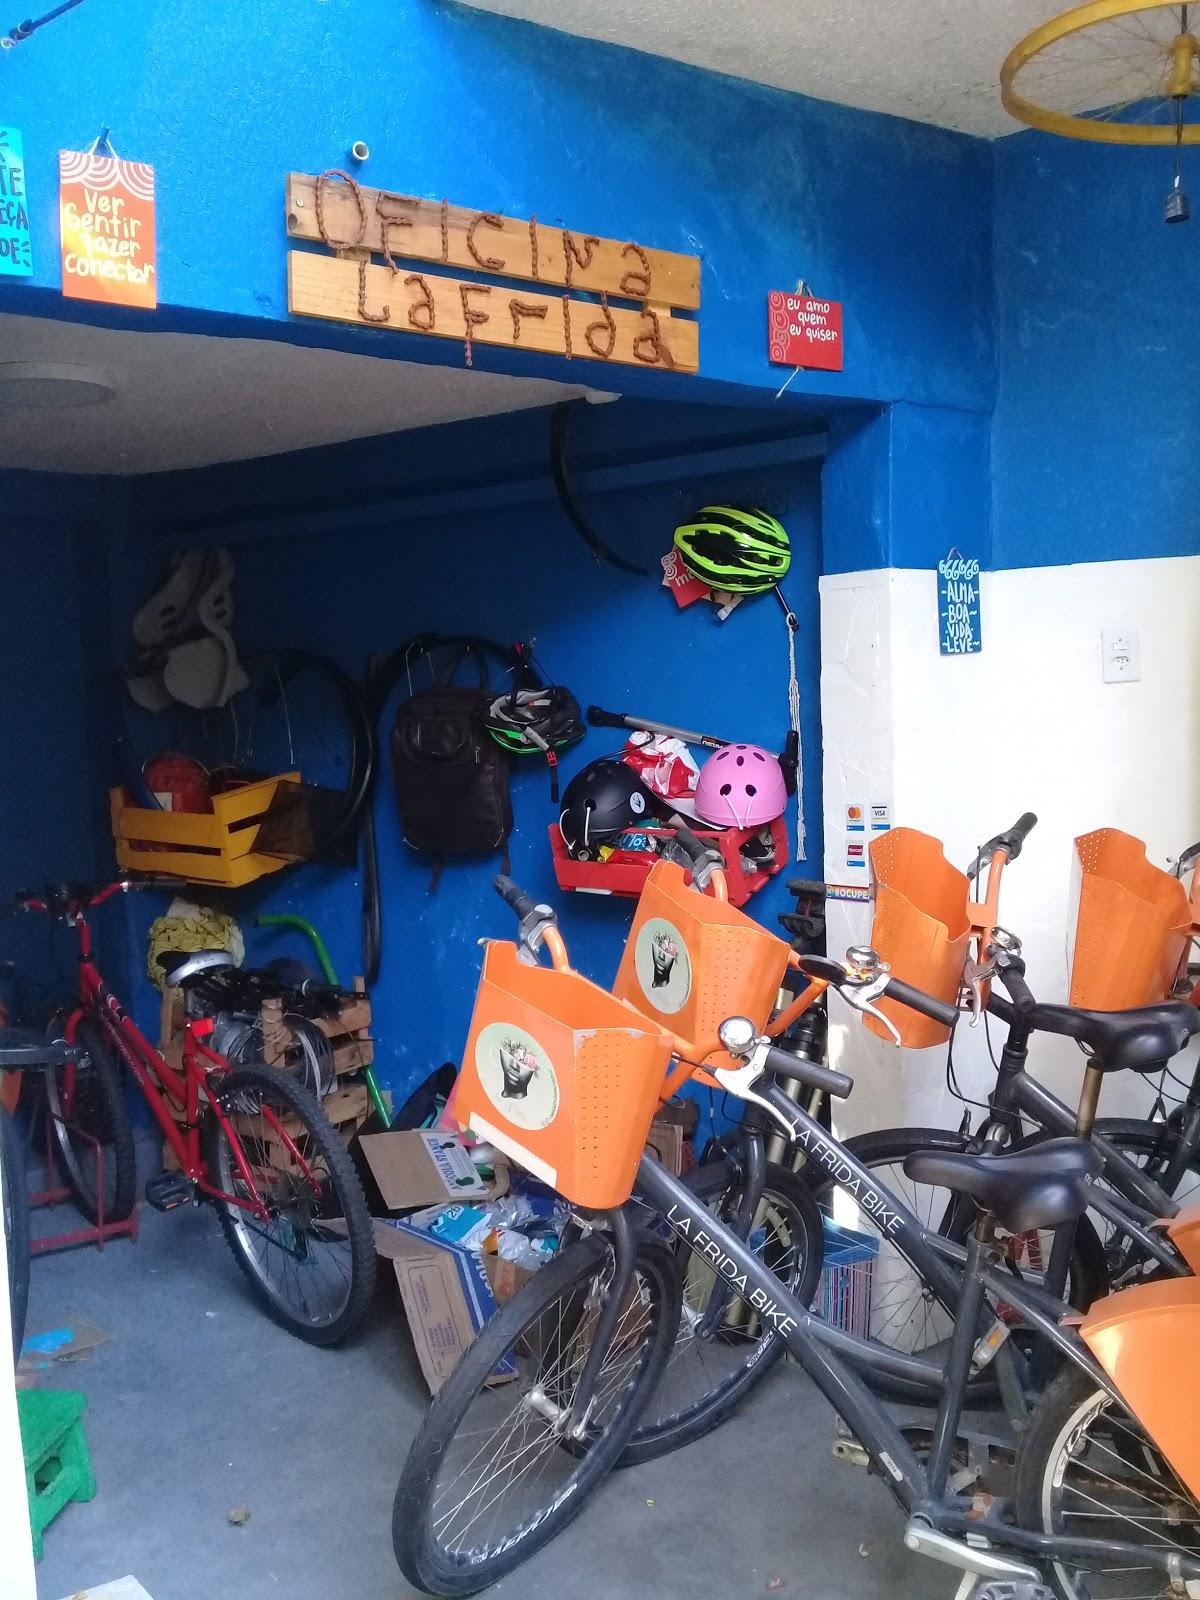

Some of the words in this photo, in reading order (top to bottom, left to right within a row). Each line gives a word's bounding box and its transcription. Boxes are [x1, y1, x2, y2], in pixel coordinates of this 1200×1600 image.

[83, 188, 125, 215] Ver
[64, 202, 142, 238] Sentir
[65, 253, 155, 284] Conector
[787, 297, 800, 310] eu
[806, 301, 829, 313] amo
[798, 311, 827, 326] quem
[789, 324, 801, 336] eu
[806, 327, 838, 343] quiser
[947, 580, 975, 604] ALMA
[948, 603, 970, 623] BOA
[947, 635, 974, 653] LEVE
[811, 1140, 861, 1195] FRIDA
[861, 1190, 905, 1234] BIKE
[667, 1204, 691, 1235] LA
[693, 1230, 748, 1292] FRIDA
[749, 1287, 798, 1338] BIKE
